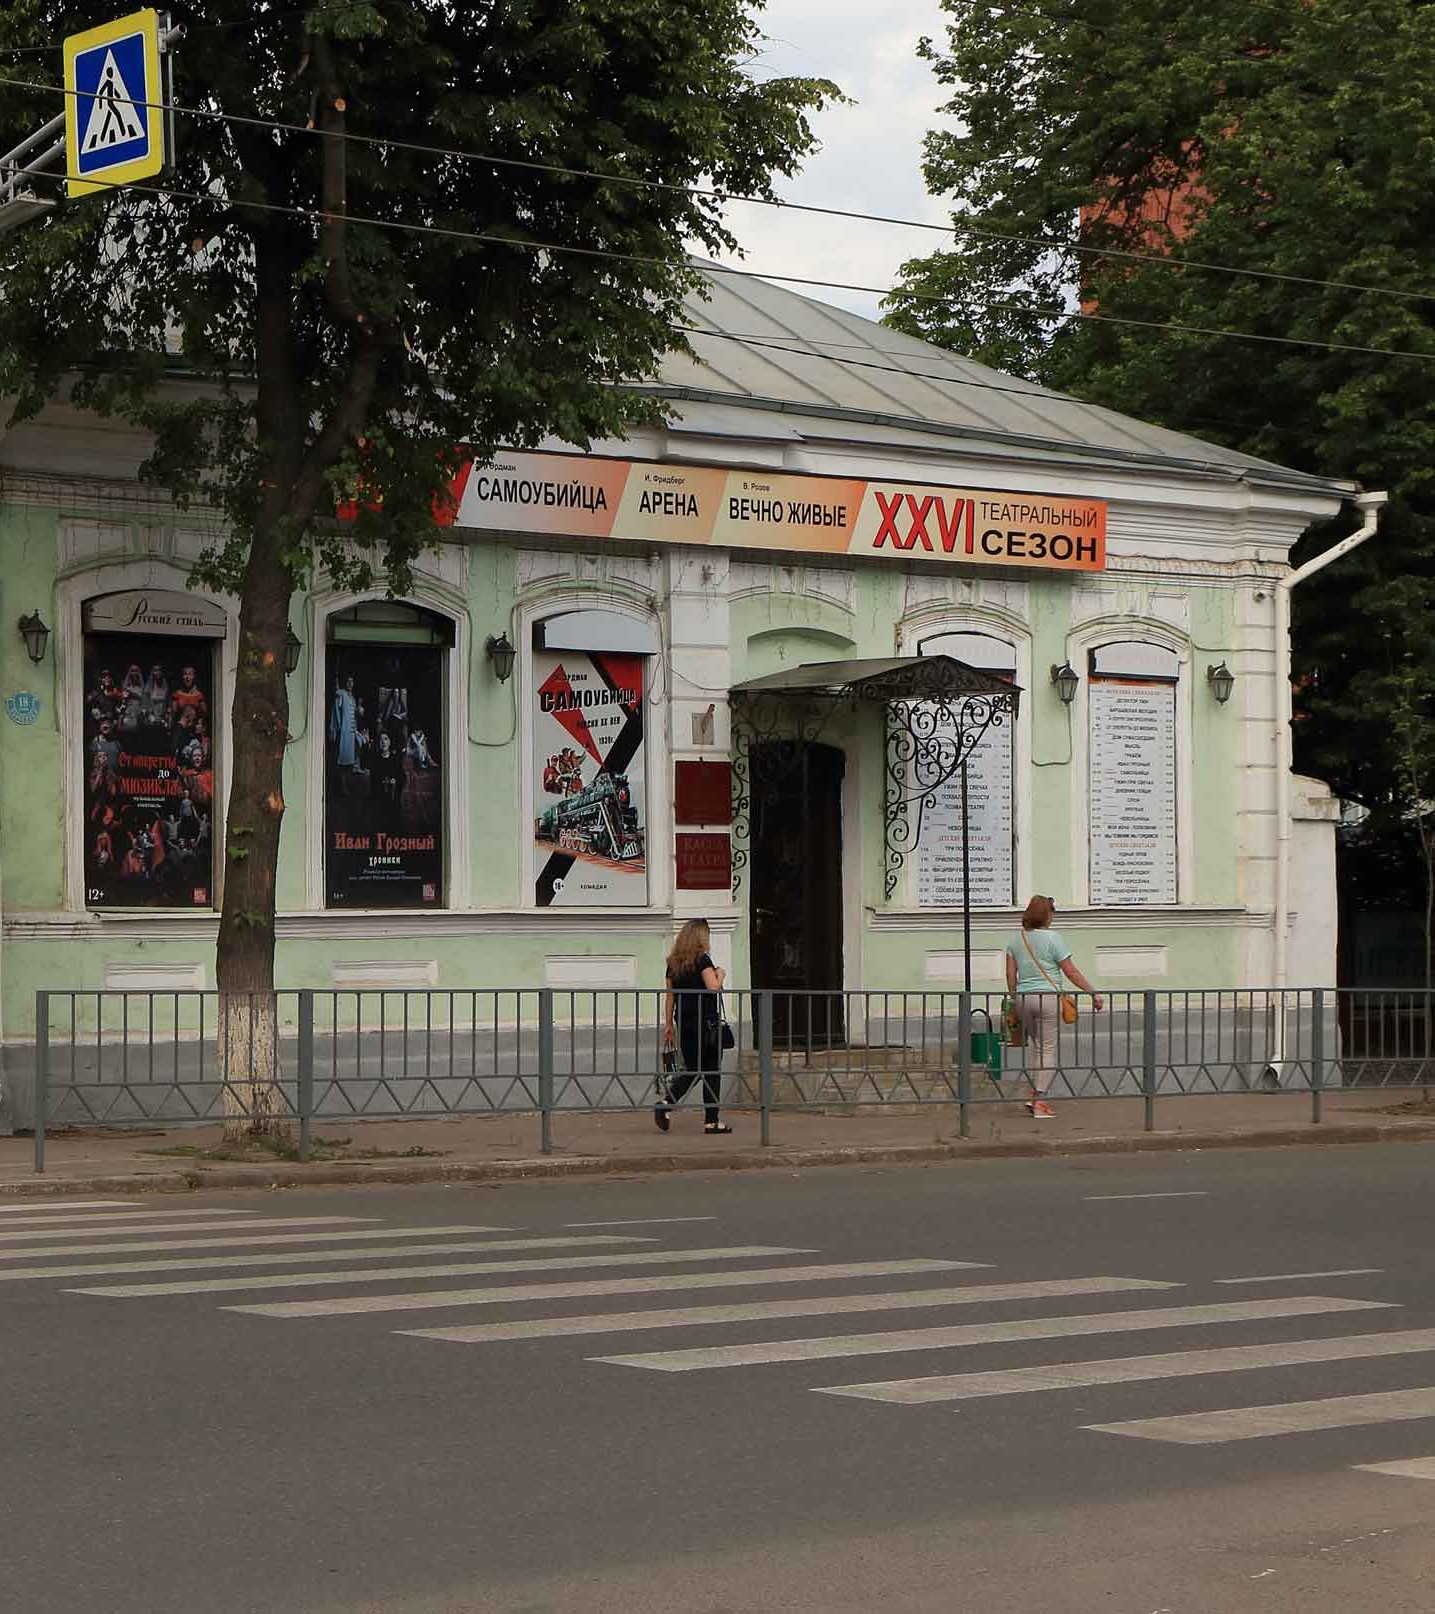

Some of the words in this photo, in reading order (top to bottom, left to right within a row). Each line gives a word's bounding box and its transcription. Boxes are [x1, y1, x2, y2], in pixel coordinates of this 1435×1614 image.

[477, 477, 607, 513] САМОУБИЙЦА
[639, 490, 699, 517] АРЕНА
[729, 497, 784, 523] ВЕЧНО
[787, 501, 847, 528] ЖИВЫЕ
[872, 491, 975, 554] XXVI
[980, 501, 1097, 528] ТЕАТРАЛЬНЫЙ
[980, 529, 1097, 562] СЕЗОН
[540, 688, 637, 713] САМОУБИЙЦА
[334, 832, 370, 850] Иван
[376, 833, 434, 855] Грозный
[88, 888, 105, 900] 12+
